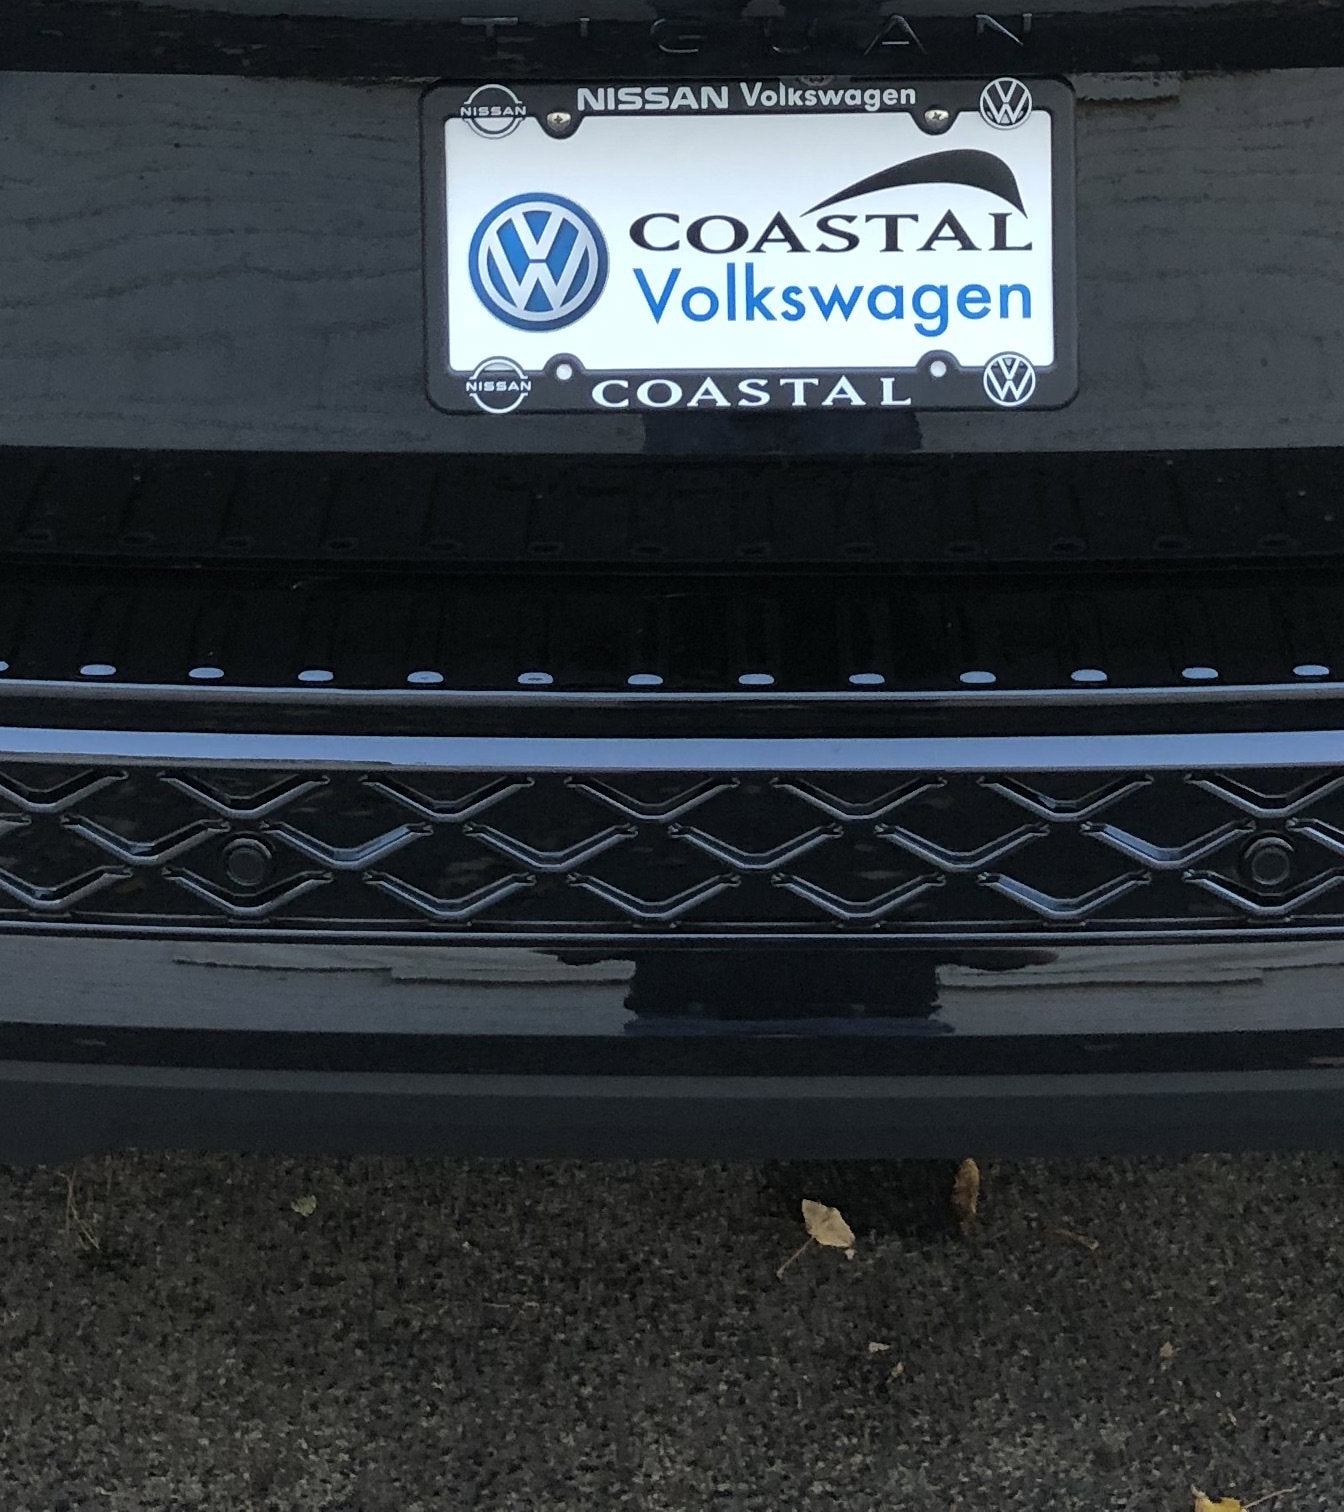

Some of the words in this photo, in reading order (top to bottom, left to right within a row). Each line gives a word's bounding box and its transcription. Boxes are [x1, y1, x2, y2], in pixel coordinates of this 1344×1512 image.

[460, 105, 527, 117] NISSAN
[577, 86, 729, 111] NISSAN
[740, 82, 916, 109] Volkswagen
[628, 210, 1033, 254] COASTAL
[633, 262, 1032, 337] Volkswagen
[465, 380, 532, 392] NISSAN
[591, 376, 912, 407] COASTAL
